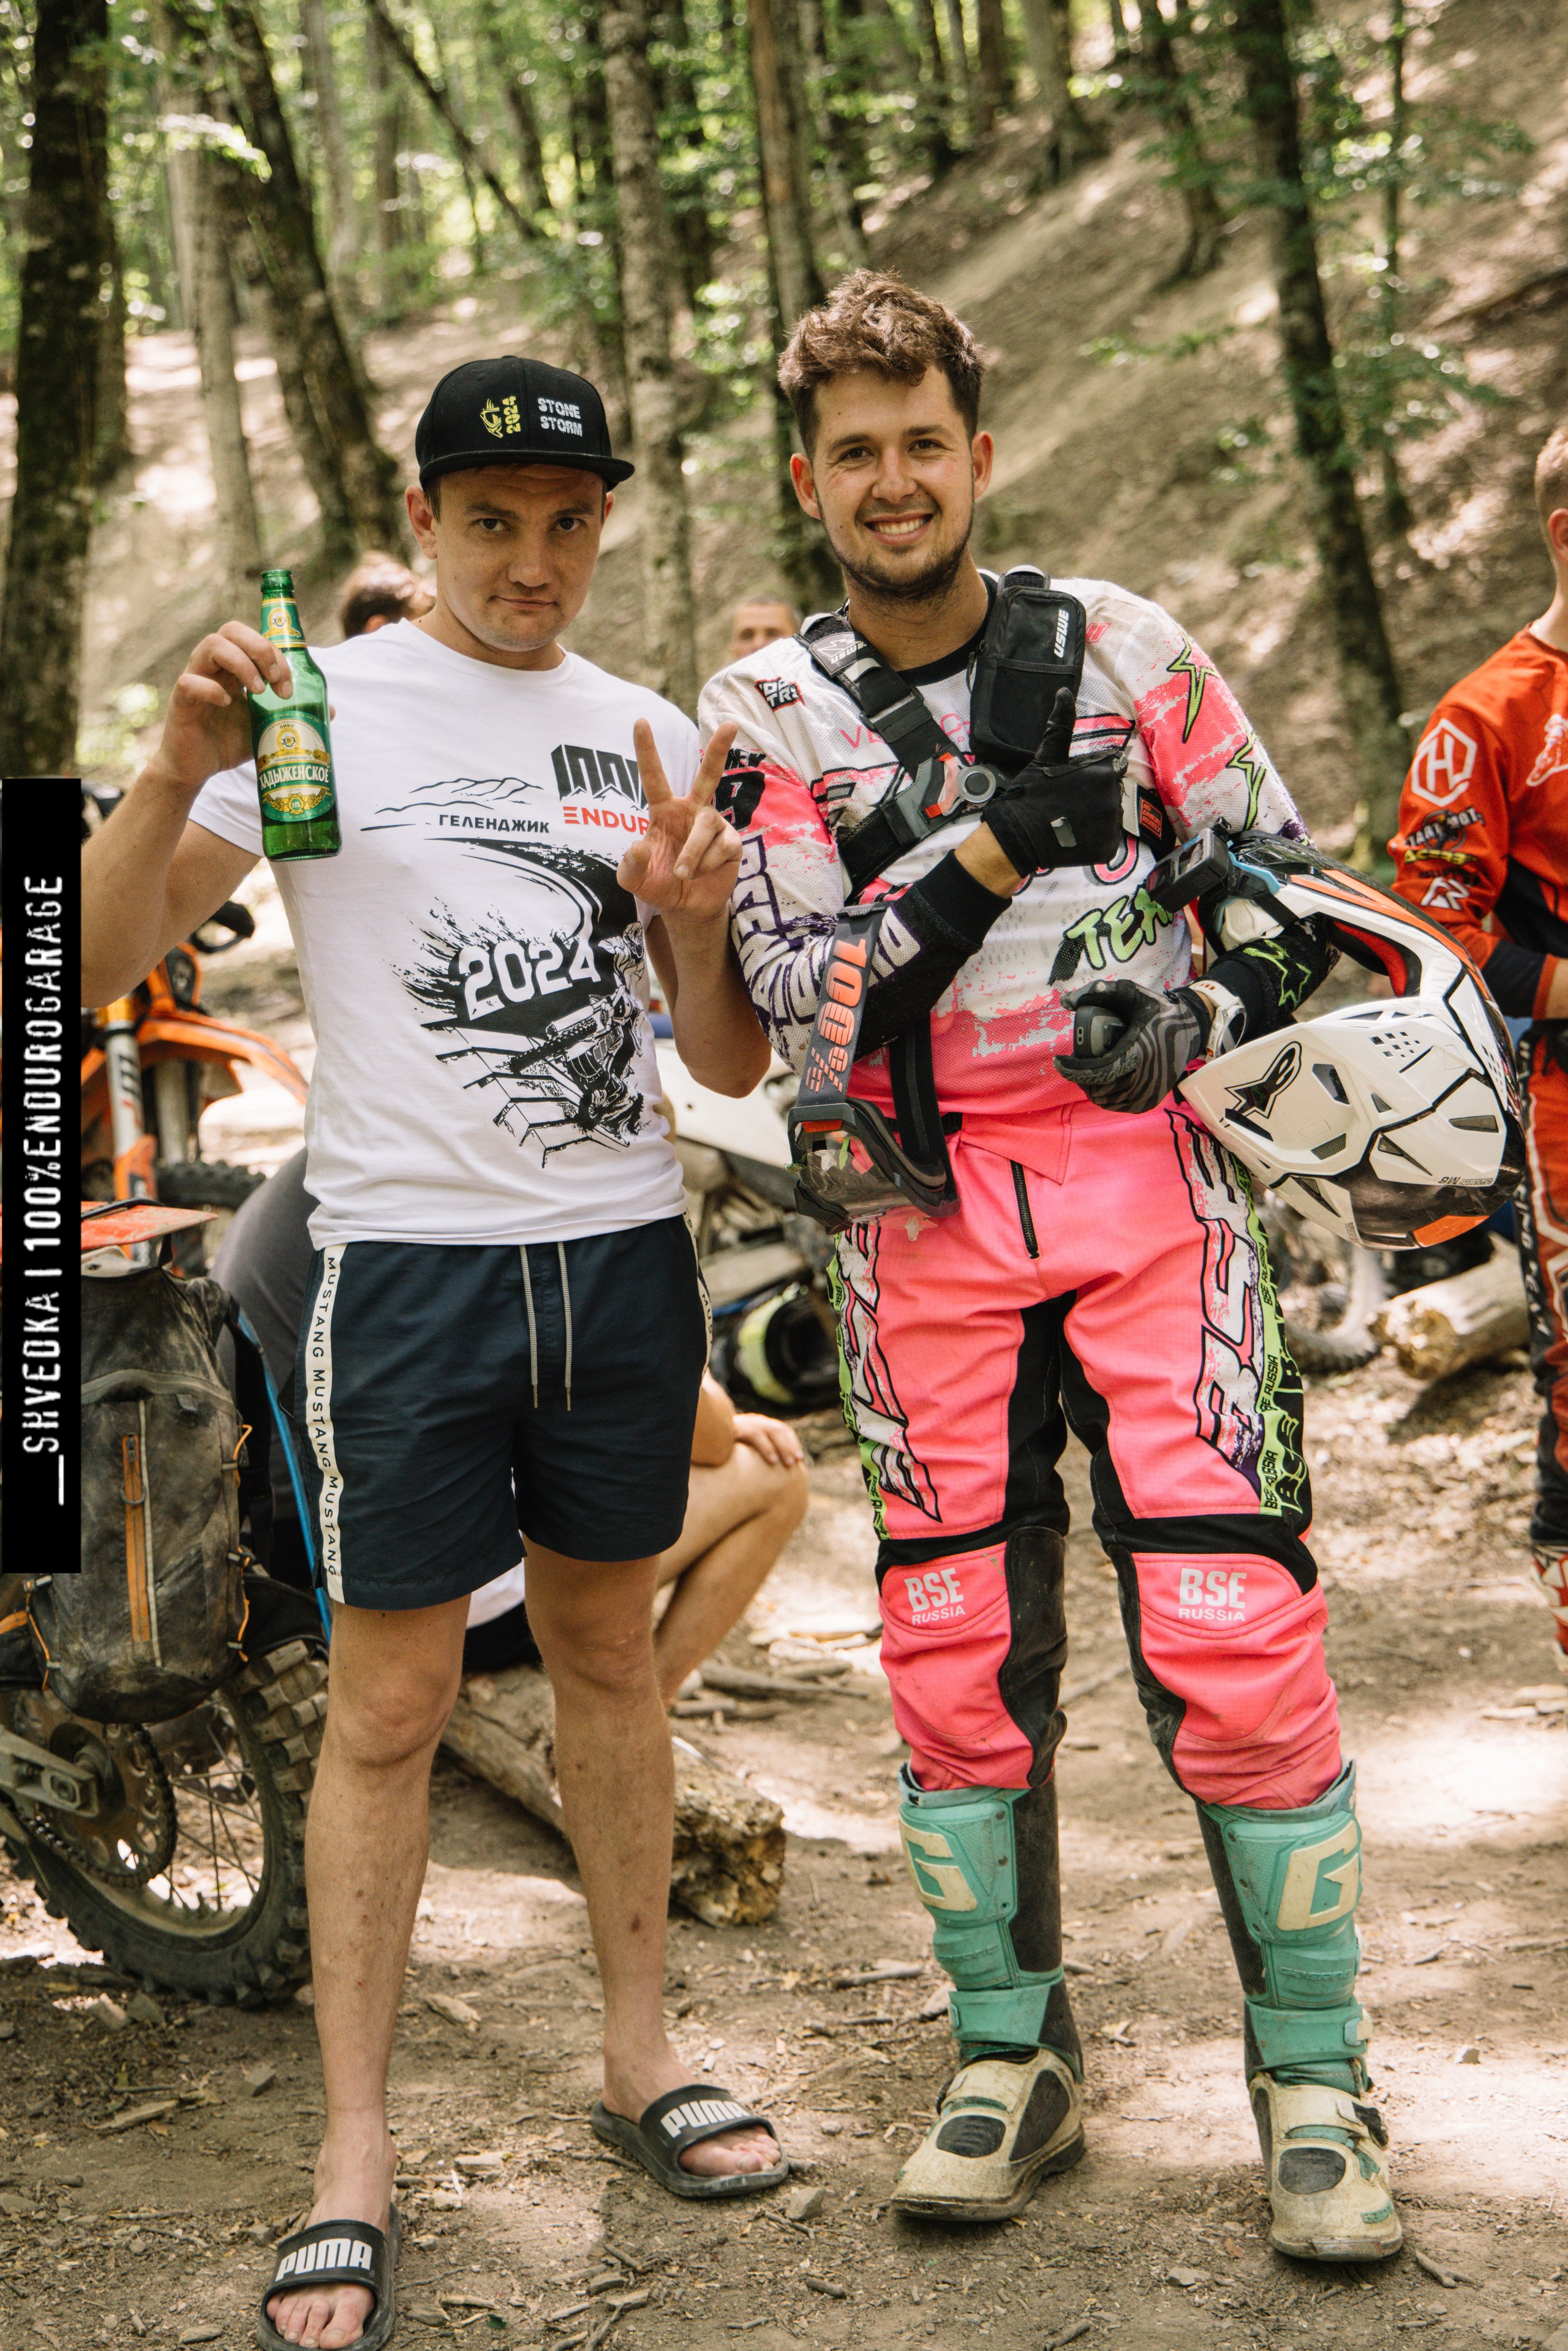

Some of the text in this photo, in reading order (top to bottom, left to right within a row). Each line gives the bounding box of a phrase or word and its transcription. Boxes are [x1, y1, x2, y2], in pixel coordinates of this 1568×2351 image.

[502, 396, 521, 434] 2024
[538, 398, 581, 420] STONE
[540, 416, 582, 437] STORM
[831, 641, 864, 664] USWE
[1054, 609, 1069, 659] USWE
[259, 765, 329, 790] ХАДЫЖЕНСКОЕ
[439, 814, 550, 834] ГЕЛЕНДЖИК
[562, 806, 649, 836] ENDUR
[458, 938, 601, 1021] 2024
[805, 939, 867, 1093] 100%
[1263, 1354, 1279, 1395] RUSSIA
[312, 1256, 339, 1577] MUSTANG MUSTANG MUSTANG
[903, 1568, 964, 1612] BSE
[1179, 1568, 1247, 1609] BSE
[911, 1605, 966, 1626] RUSSIA
[1178, 1607, 1246, 1622] RUSSIA
[660, 2099, 750, 2138] PUMA
[274, 2238, 373, 2282] PUMA
